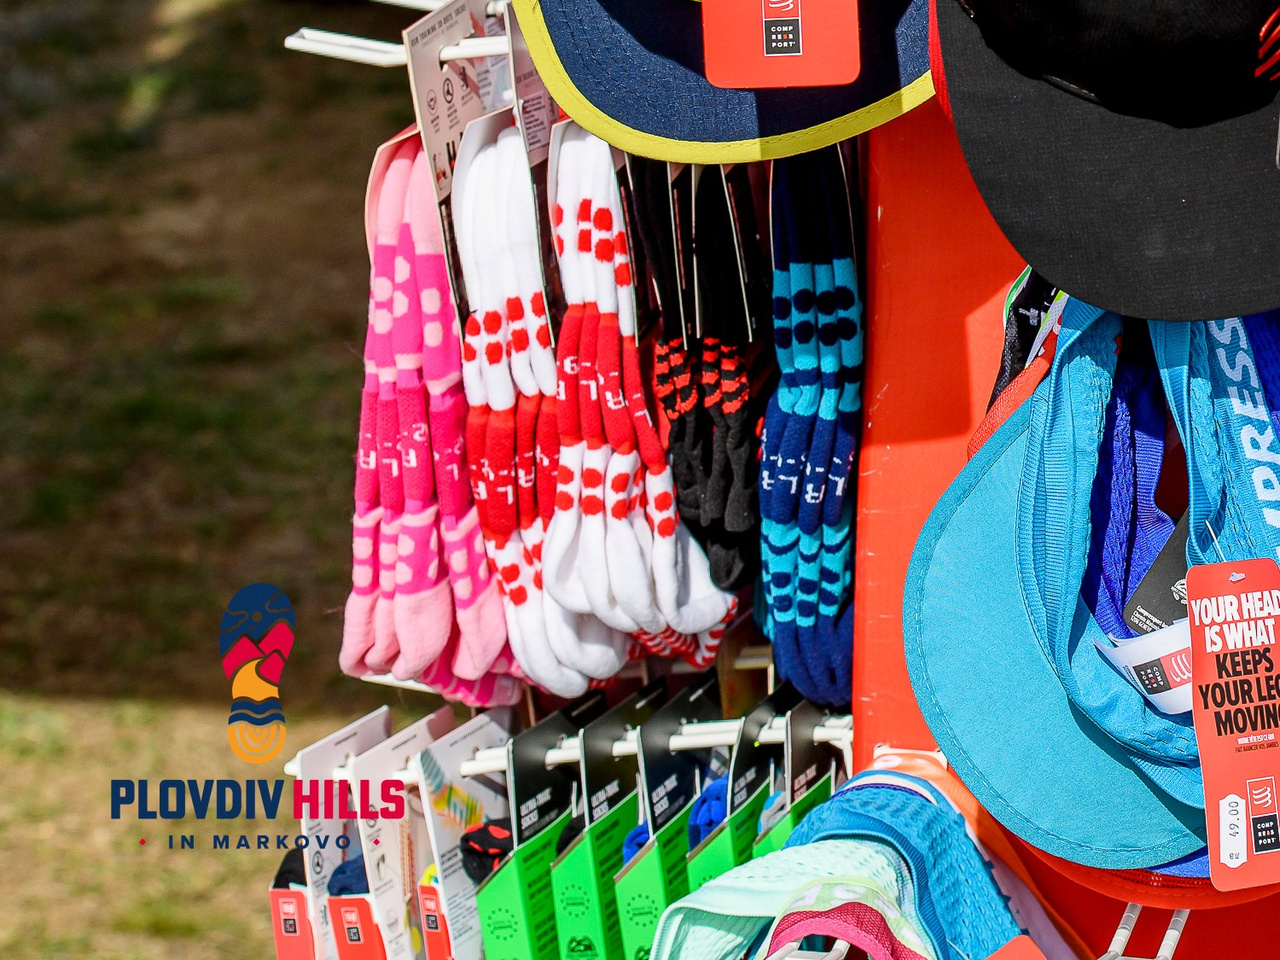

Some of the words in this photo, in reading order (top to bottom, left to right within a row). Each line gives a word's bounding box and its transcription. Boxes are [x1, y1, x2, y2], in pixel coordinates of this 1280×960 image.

[1191, 594, 1240, 626] YOUR
[1204, 625, 1223, 653] IS
[1222, 618, 1276, 650] WHAT
[1215, 647, 1274, 679] KEEPS
[1198, 679, 1253, 710] YOUR
[1228, 801, 1240, 837] 49.00
[1256, 821, 1274, 829] COMP
